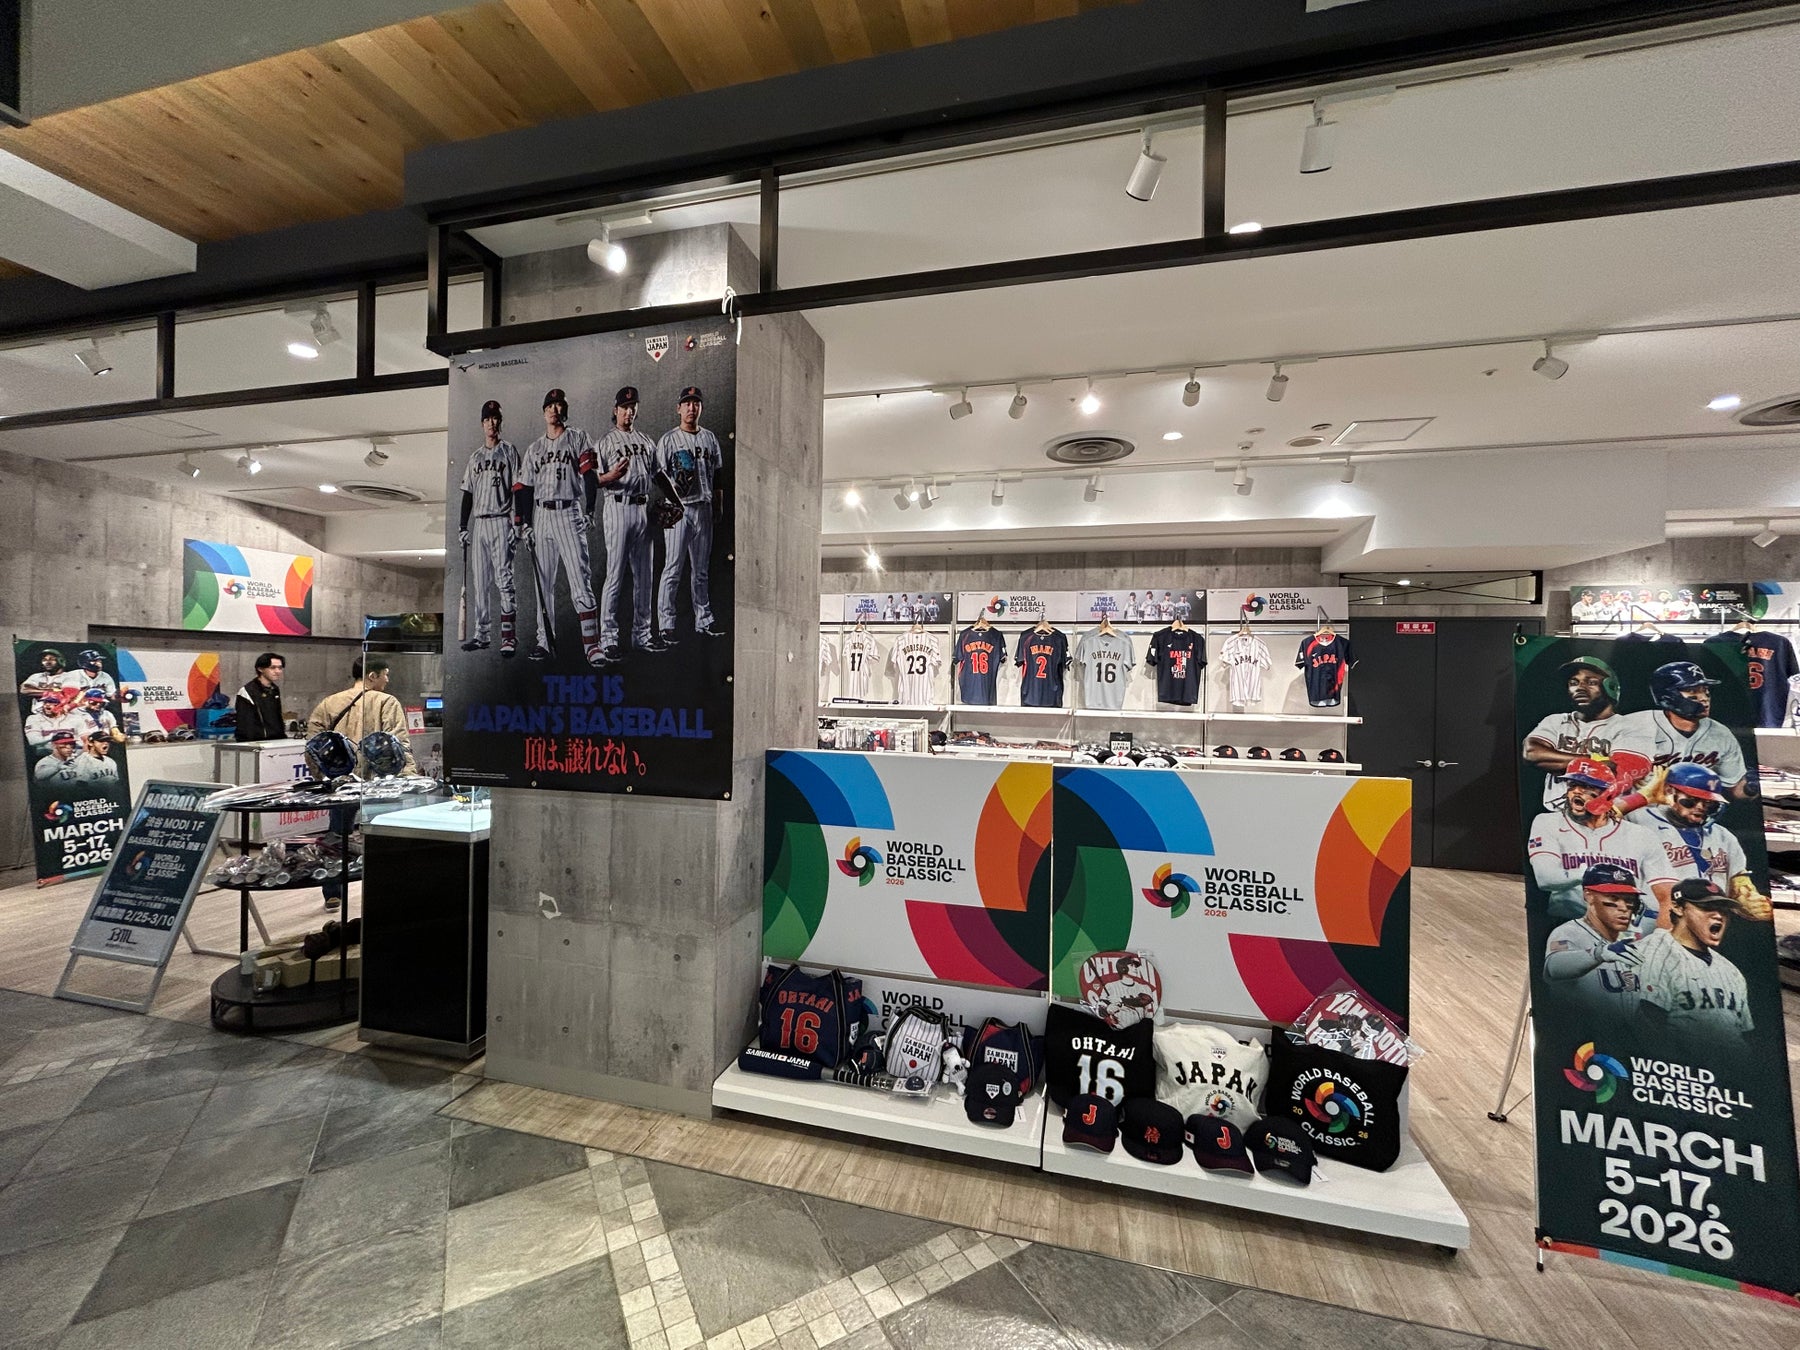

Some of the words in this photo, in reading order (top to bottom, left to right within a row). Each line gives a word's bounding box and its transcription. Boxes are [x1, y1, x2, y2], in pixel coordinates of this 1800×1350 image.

[648, 342, 668, 351] JAPAN
[478, 361, 500, 370] MIZUNO
[501, 358, 528, 368] BASEBALL
[535, 451, 572, 473] JAPAN
[616, 445, 648, 461] JAPA
[473, 459, 506, 478] JAPAN
[556, 467, 566, 481] 51
[247, 586, 281, 594] BASEBALL
[964, 641, 994, 654] OHTANI
[1091, 650, 1122, 661] OHTANI
[850, 652, 862, 672] 17
[906, 654, 927, 674] 23
[971, 652, 988, 674] 16
[1036, 656, 1048, 678] 2
[1096, 662, 1116, 683] 16
[542, 674, 597, 704] THIS
[603, 674, 624, 704] IS
[464, 704, 565, 735] JAPAN'S
[570, 706, 712, 738] BASEBALL
[524, 736, 646, 776] 頂は、譲れない。
[73, 798, 106, 806] WORLD
[74, 802, 120, 812] BASEBALL
[144, 793, 195, 811] BASEBALL
[74, 808, 112, 818] CLASSIC
[43, 818, 124, 842] MARCH
[163, 818, 188, 831] MODI
[192, 820, 206, 832] 1F
[128, 836, 164, 848] BASEBALL
[164, 840, 186, 850] AREA
[886, 840, 944, 856] WORLD
[62, 848, 113, 869] 2026
[150, 861, 186, 872] BASEBALL
[154, 854, 180, 862] WORLD
[886, 854, 966, 871] BASEBALL
[146, 868, 178, 878] CLASSIC
[886, 866, 953, 882] CLASSIC
[886, 878, 904, 886] 2026
[1205, 867, 1276, 884] WORLD
[1205, 882, 1304, 902] BASEBALL
[1204, 896, 1288, 914] CLASSIC
[1204, 909, 1228, 918] 2026
[124, 910, 175, 926] 2/25-3/10
[1083, 957, 1157, 988] OHTNI
[778, 990, 834, 1014] OHTANI
[882, 990, 944, 1010] WORLD
[780, 1008, 822, 1054] 16
[902, 1046, 932, 1062] JAPAN
[904, 1038, 934, 1053] SAMURAI
[986, 1049, 1016, 1060] SAMURAI
[1071, 1036, 1136, 1060] OHTANI
[746, 1048, 778, 1060] SAMURAI
[786, 1056, 811, 1068] JAPAN
[1630, 1056, 1715, 1084] WORLD
[1077, 1054, 1126, 1108] 16
[1175, 1061, 1258, 1104] JAPAN
[1632, 1072, 1753, 1108] BASEBALL
[1204, 1090, 1218, 1106] WORLD
[1291, 1068, 1322, 1101] WORLD
[1323, 1068, 1375, 1127] BASEBALL
[1632, 1088, 1732, 1119] CLASSIC
[1082, 1104, 1098, 1125] J
[1292, 1106, 1304, 1116] 20
[1144, 1126, 1160, 1144] 侍
[1217, 1126, 1232, 1150] J
[1278, 1136, 1296, 1146] WORLD
[1301, 1121, 1356, 1146] CLASSIC
[1358, 1130, 1369, 1140] 26
[1278, 1141, 1302, 1152] BASEBALL
[1278, 1146, 1300, 1154] CLASSIC
[1560, 1110, 1766, 1183] MARCH
[1598, 1198, 1734, 1260] 2026
